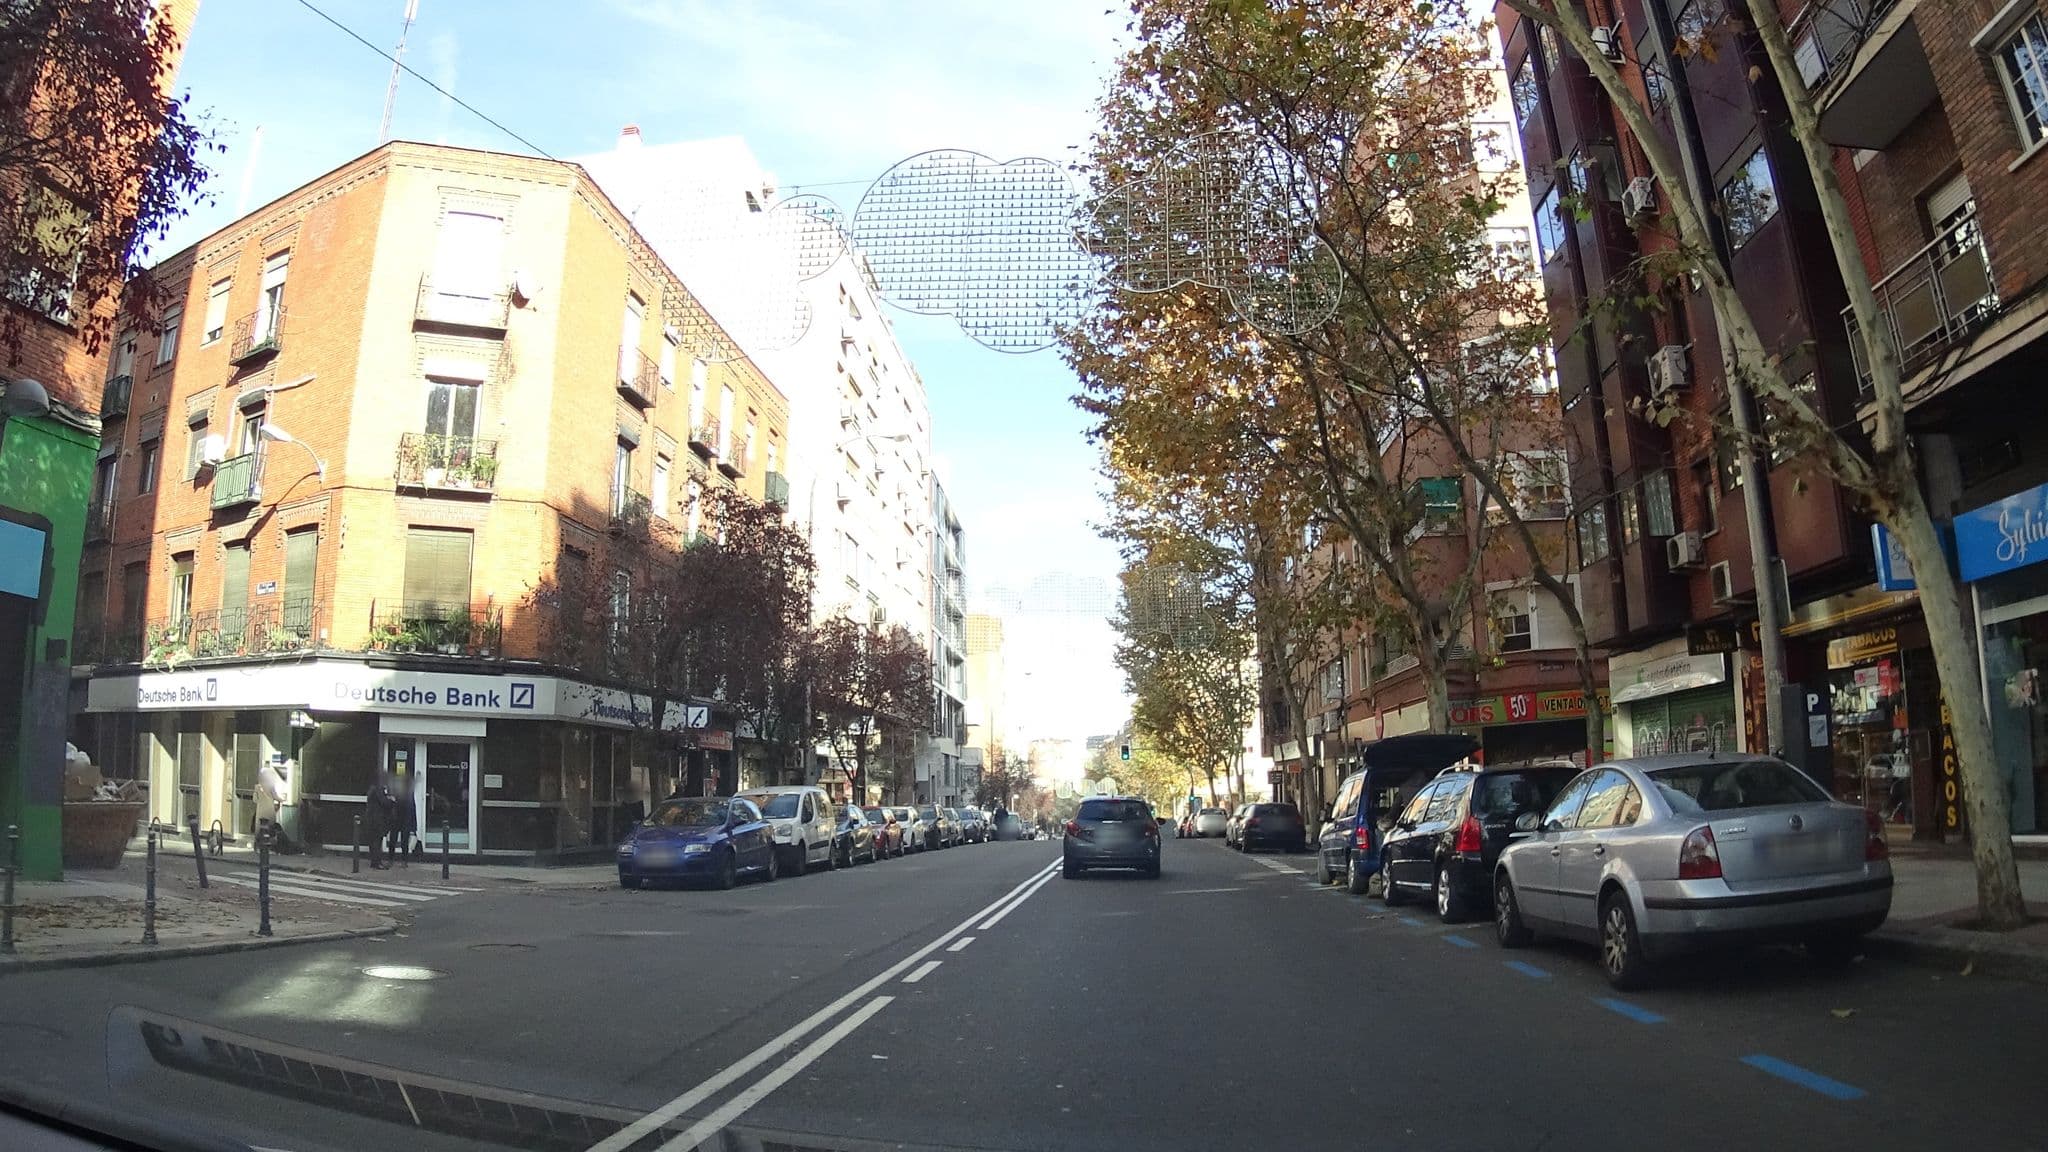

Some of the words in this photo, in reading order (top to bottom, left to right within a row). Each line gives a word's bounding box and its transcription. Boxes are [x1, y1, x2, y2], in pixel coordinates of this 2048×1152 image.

[138, 687, 177, 703] Deutsche
[180, 685, 202, 702] Bank
[334, 681, 437, 704] Deutsche
[446, 687, 500, 708] Bank
[1806, 693, 1819, 712] P
[1544, 698, 1574, 712] VENTA
